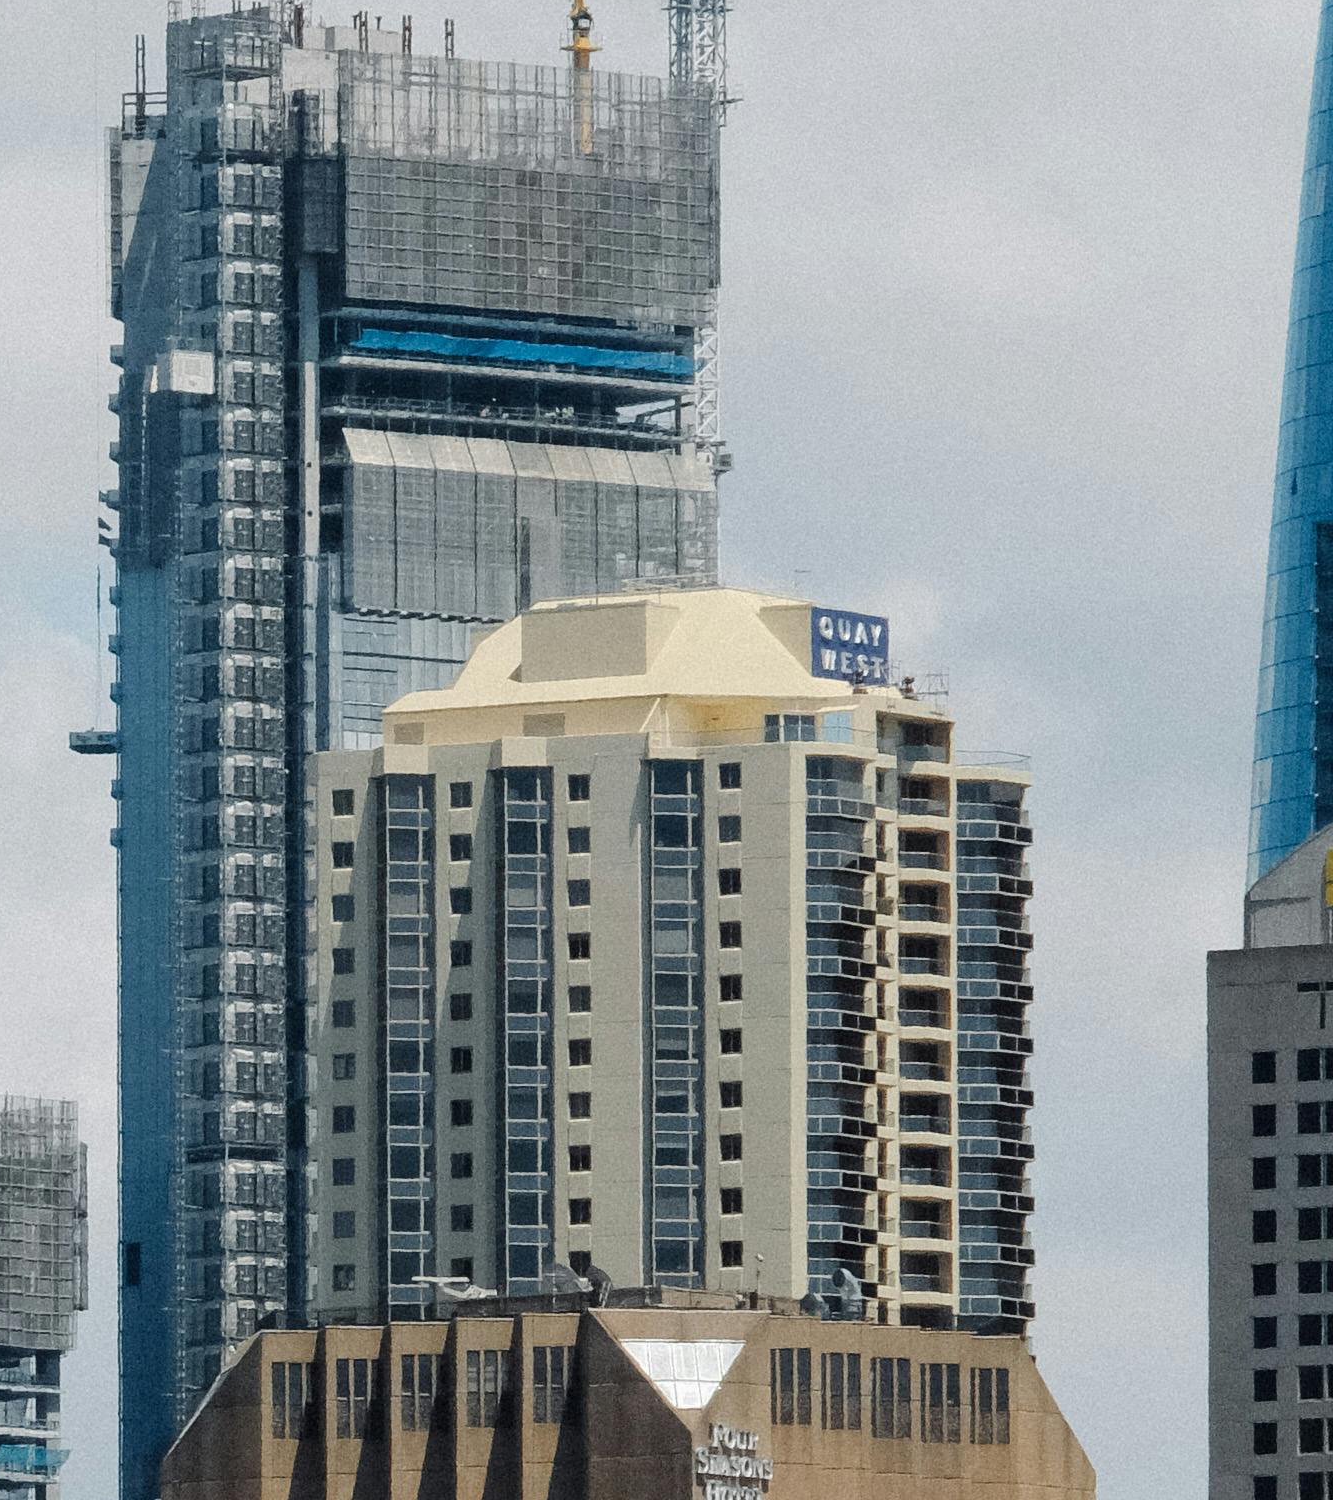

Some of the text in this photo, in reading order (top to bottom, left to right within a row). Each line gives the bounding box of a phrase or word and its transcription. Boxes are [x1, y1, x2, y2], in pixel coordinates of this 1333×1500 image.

[818, 616, 882, 647] QUAY
[820, 648, 885, 679] WEST
[711, 1423, 759, 1450] FOUR
[695, 1446, 774, 1480] SEASONS
